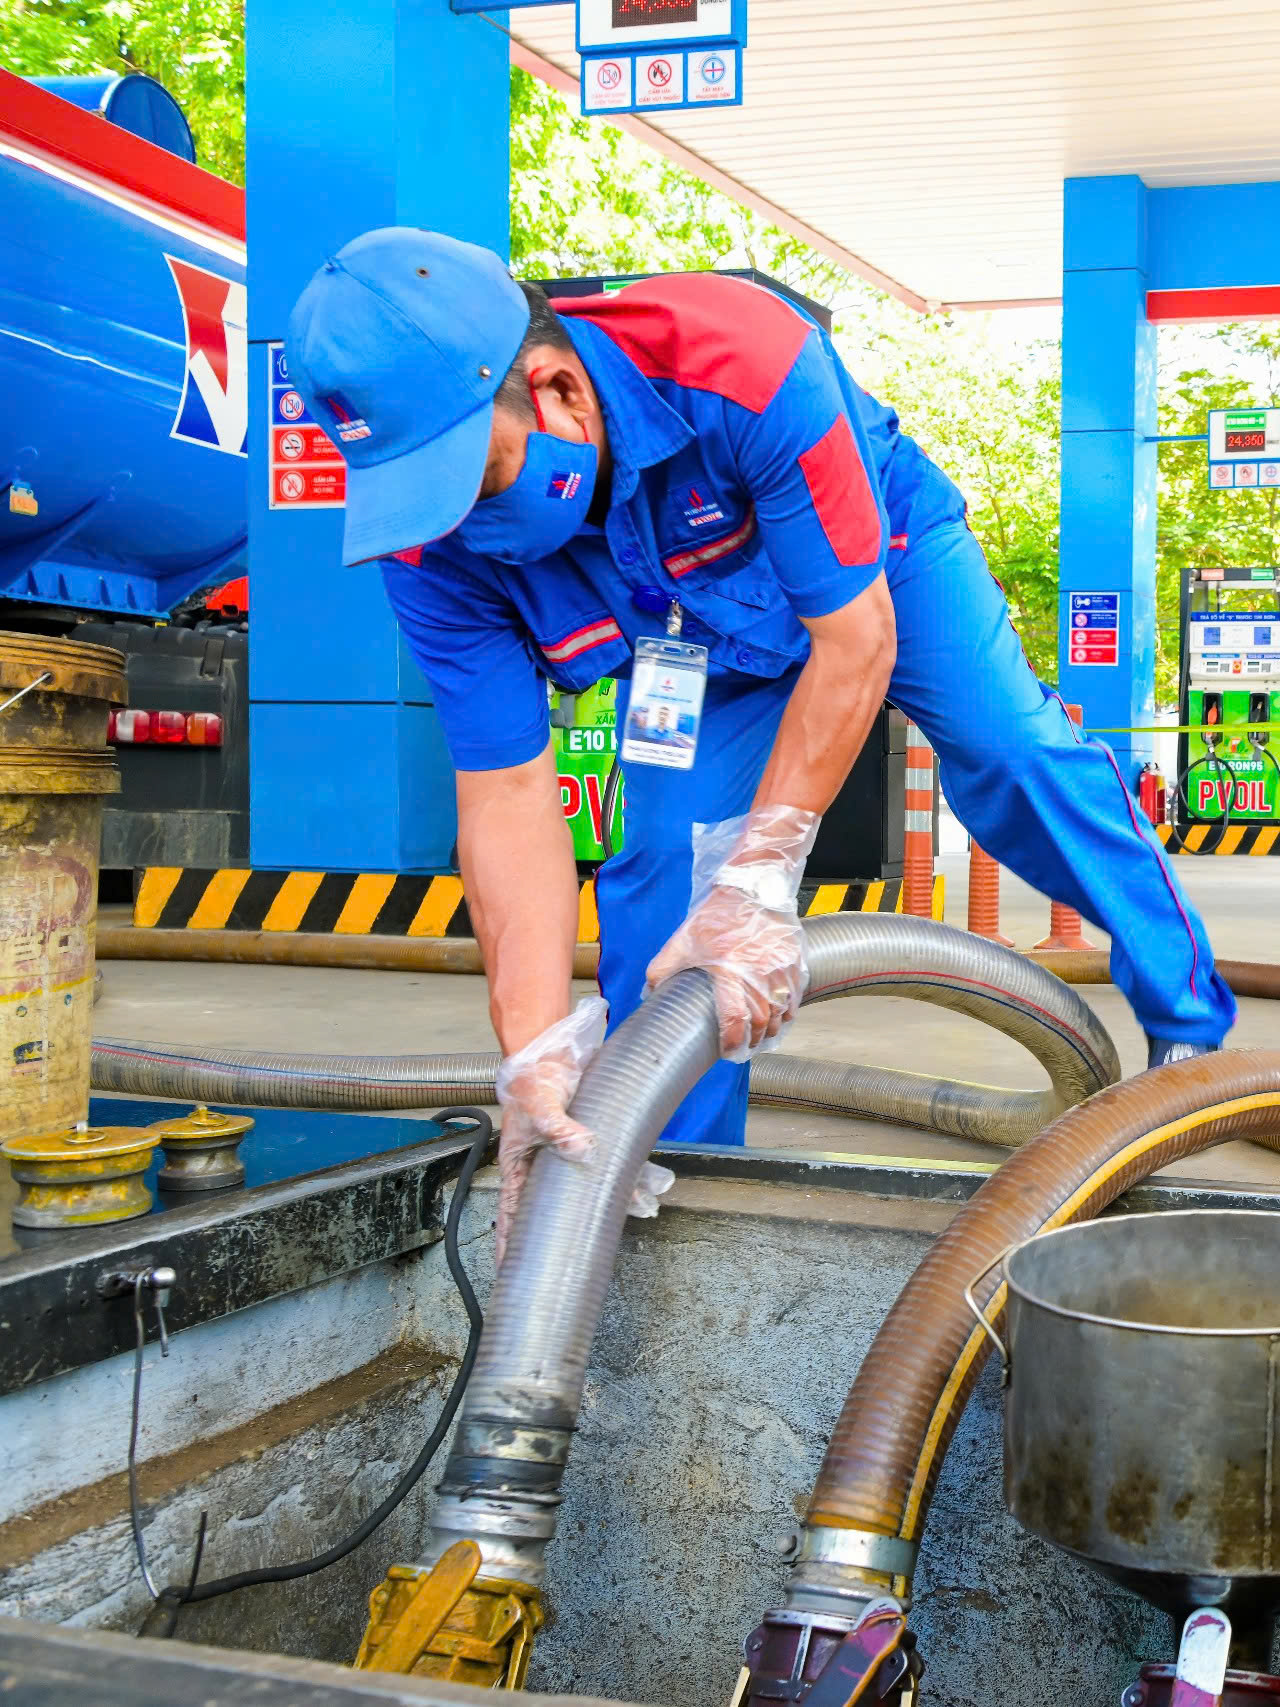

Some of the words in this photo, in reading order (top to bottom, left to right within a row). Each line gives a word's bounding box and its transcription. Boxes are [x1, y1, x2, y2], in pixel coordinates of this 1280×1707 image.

[1227, 434, 1264, 448] 24,350
[569, 729, 605, 751] E10
[1199, 780, 1272, 812] PVOIL
